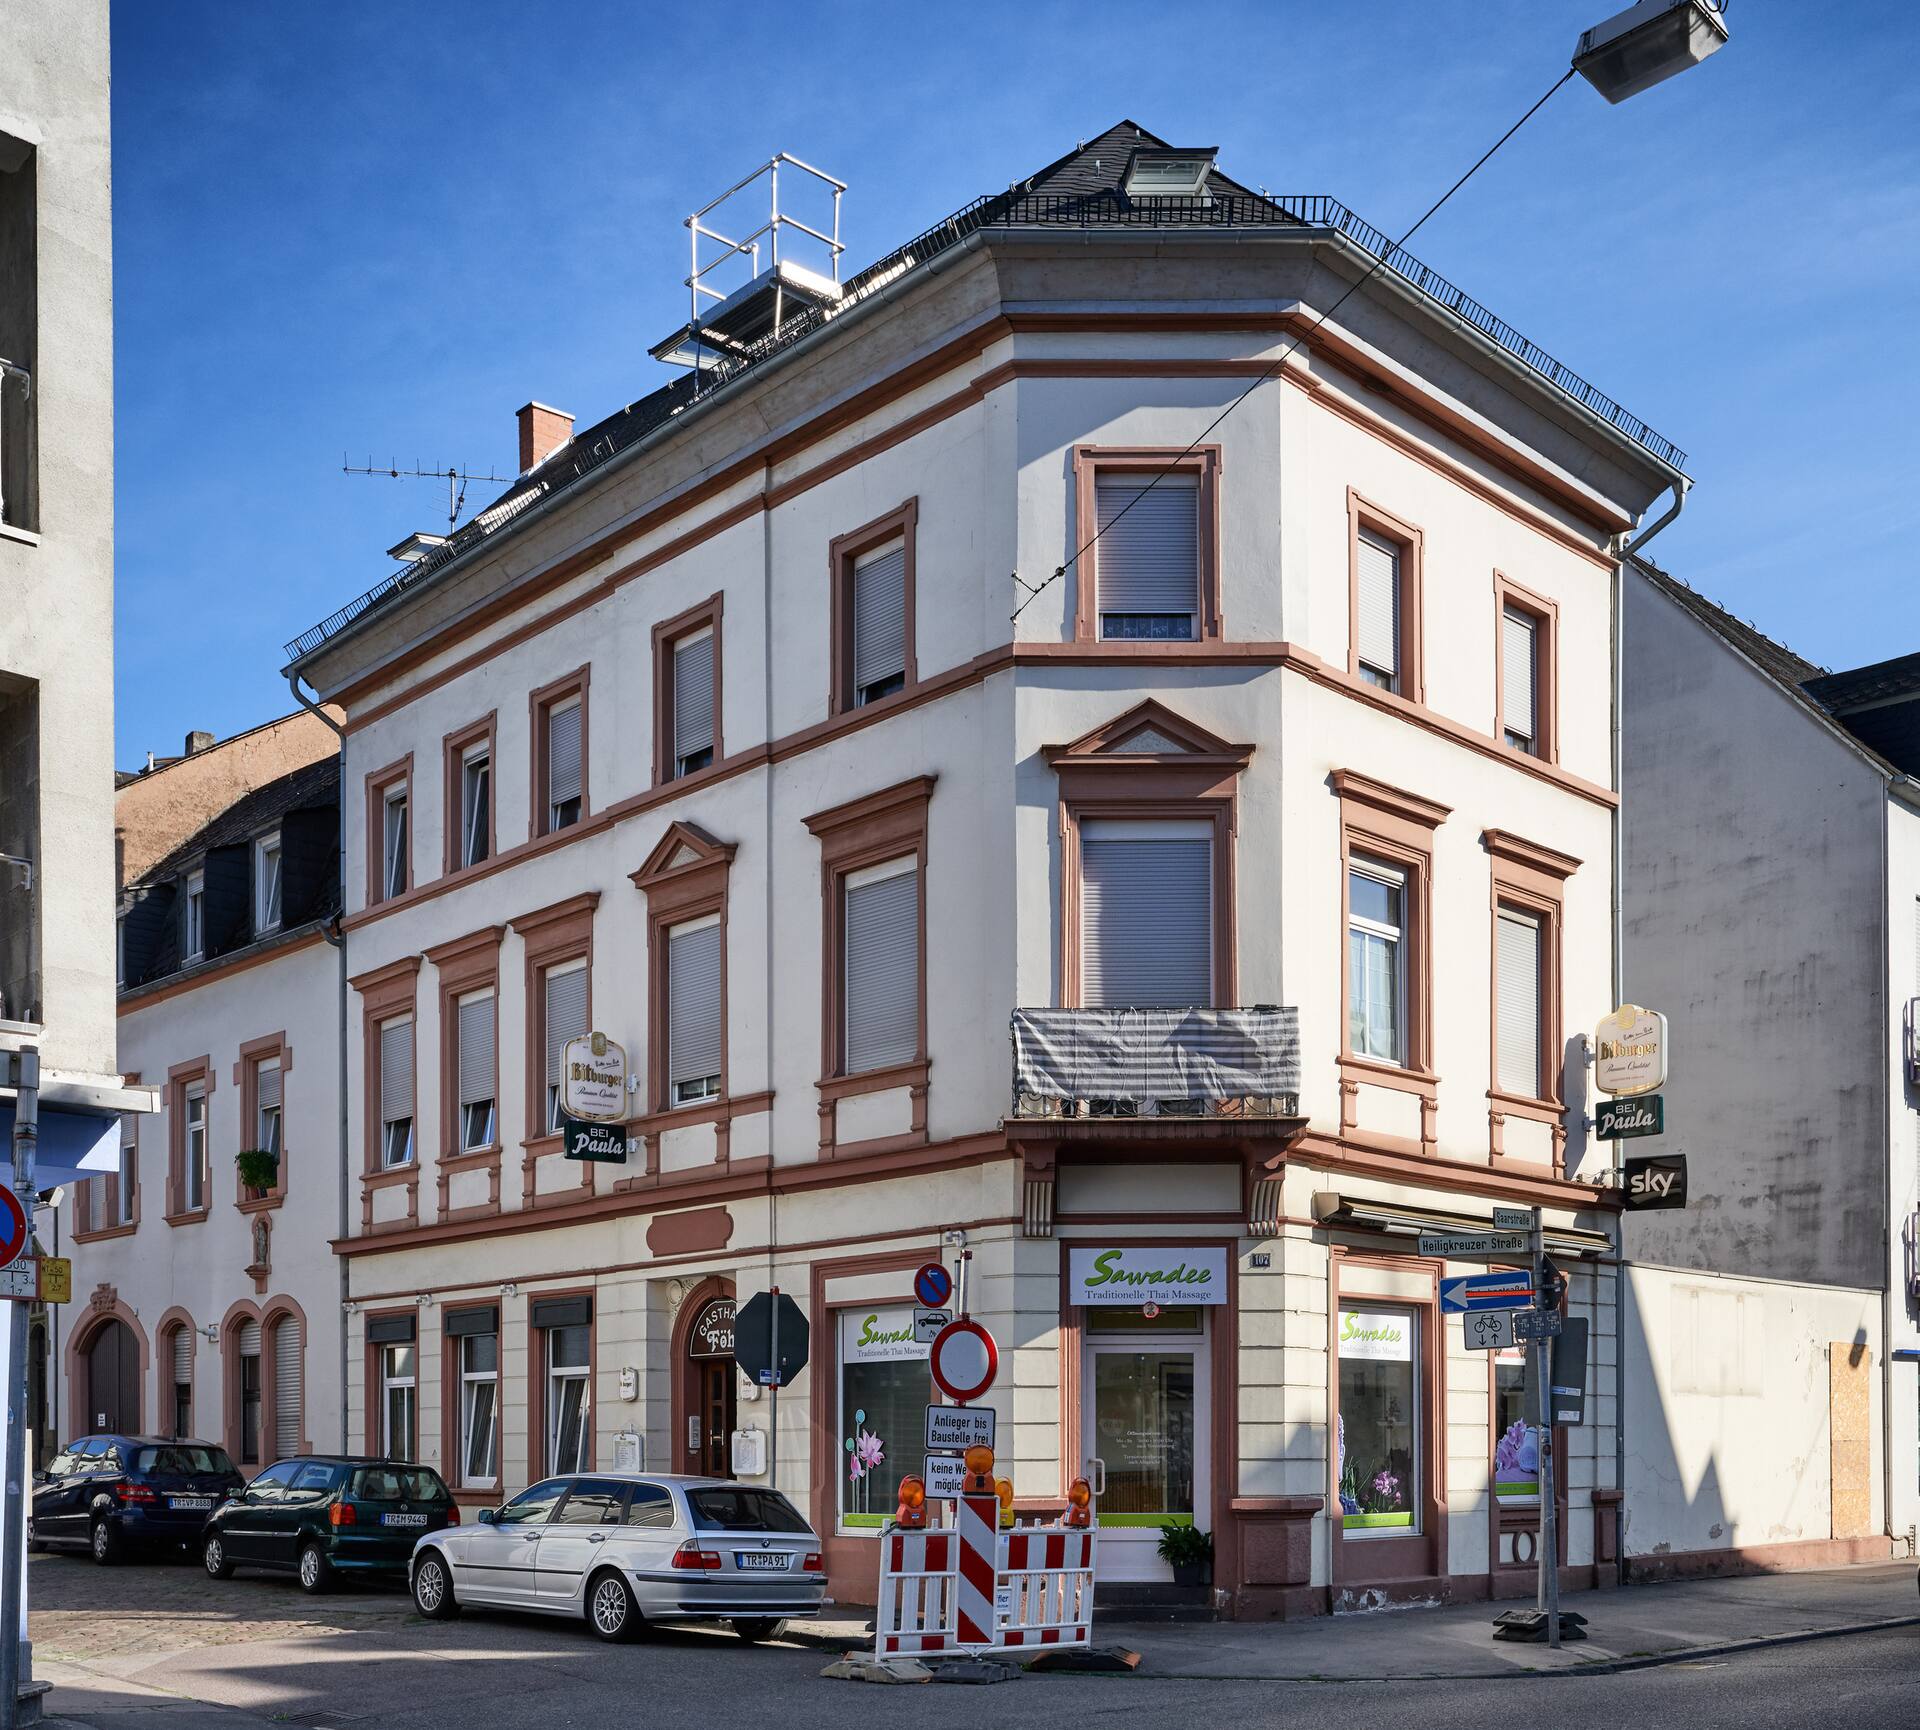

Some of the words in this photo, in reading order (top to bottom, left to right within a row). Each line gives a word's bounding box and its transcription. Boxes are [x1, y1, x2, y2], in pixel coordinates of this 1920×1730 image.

[1600, 1040, 1656, 1061] Bitburger
[571, 1063, 622, 1087] Bitburger
[1615, 1103, 1636, 1114] BEI
[1599, 1108, 1656, 1136] Paula
[590, 1128, 609, 1138] BEI
[572, 1133, 623, 1154] Paula
[1630, 1168, 1675, 1197] sky
[1496, 1212, 1530, 1226] Saarstraße
[1422, 1240, 1487, 1253] Heiligkreuzer
[1491, 1238, 1523, 1249] Straße
[1084, 1250, 1212, 1287] Sawadee
[1085, 1290, 1145, 1299] Traditionelle
[1147, 1290, 1169, 1299] Thai
[1172, 1290, 1212, 1301] Massage
[699, 1307, 736, 1337] GASTHA
[1340, 1311, 1401, 1341] Sawadee
[857, 1314, 915, 1347] Sawad
[706, 1329, 735, 1353] Föh
[857, 1348, 890, 1358] Traditionelle
[904, 1347, 926, 1356] Massage
[934, 1414, 970, 1430] Anlieger
[974, 1417, 987, 1429] bis
[931, 1430, 970, 1443] Baustelle
[974, 1432, 988, 1444] frei
[931, 1462, 953, 1473] keine
[955, 1463, 966, 1475] We
[934, 1479, 963, 1493] möglic
[386, 1514, 396, 1523] TR
[746, 1555, 757, 1566] TR
[761, 1555, 773, 1566] PA
[775, 1555, 785, 1566] 91
